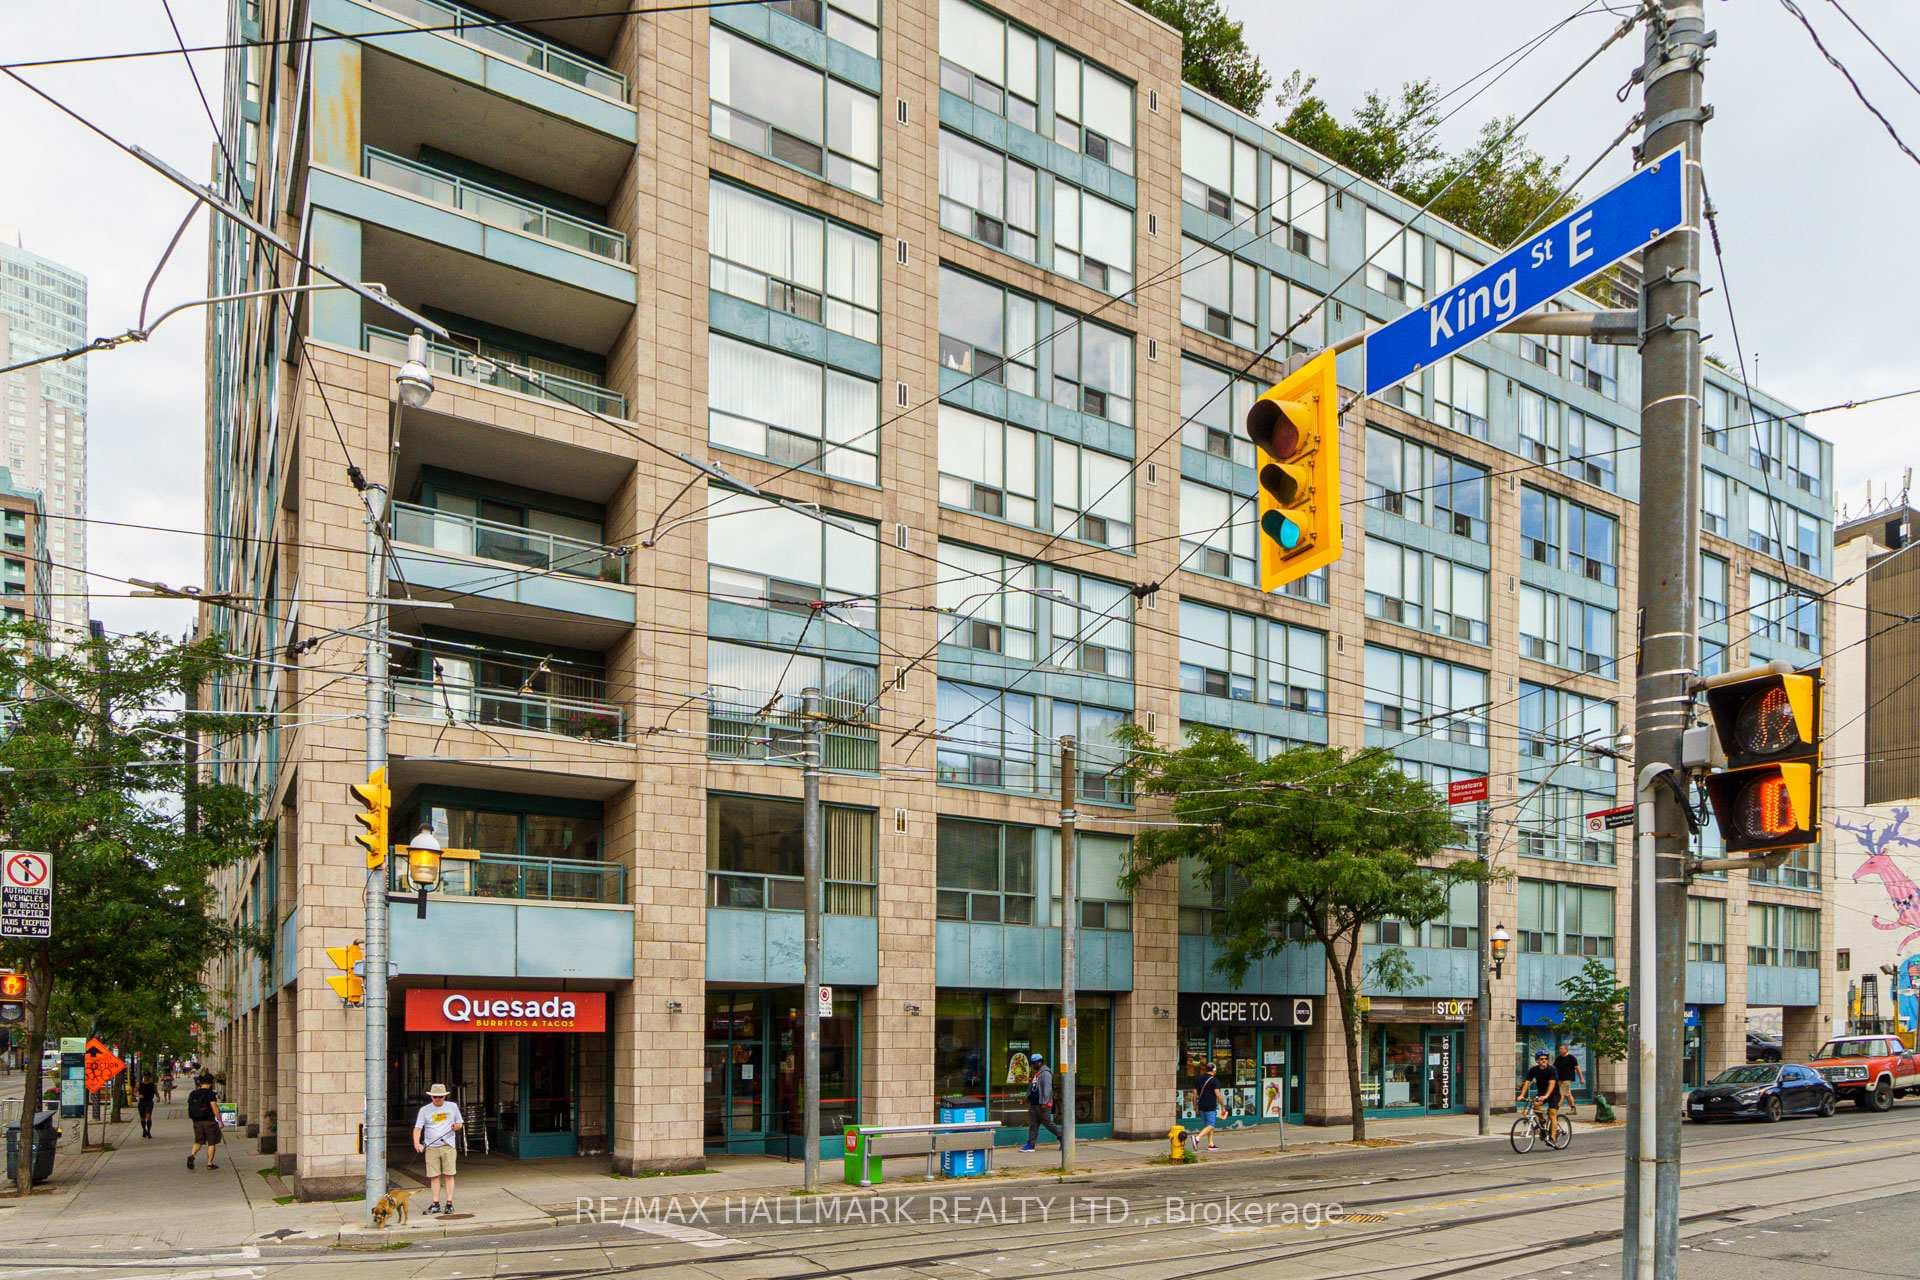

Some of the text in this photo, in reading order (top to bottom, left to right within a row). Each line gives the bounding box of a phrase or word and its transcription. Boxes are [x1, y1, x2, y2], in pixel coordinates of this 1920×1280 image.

[1430, 210, 1594, 348] King St E
[9, 894, 43, 902] VEHICLES
[20, 902, 49, 910] BICYCLES
[7, 909, 44, 917] EXCEPTED
[21, 919, 49, 927] EXCEPTED
[442, 994, 576, 1022] Quesada
[1200, 1001, 1273, 1021] CREPE T.O.
[475, 1019, 528, 1027] BURRITOS
